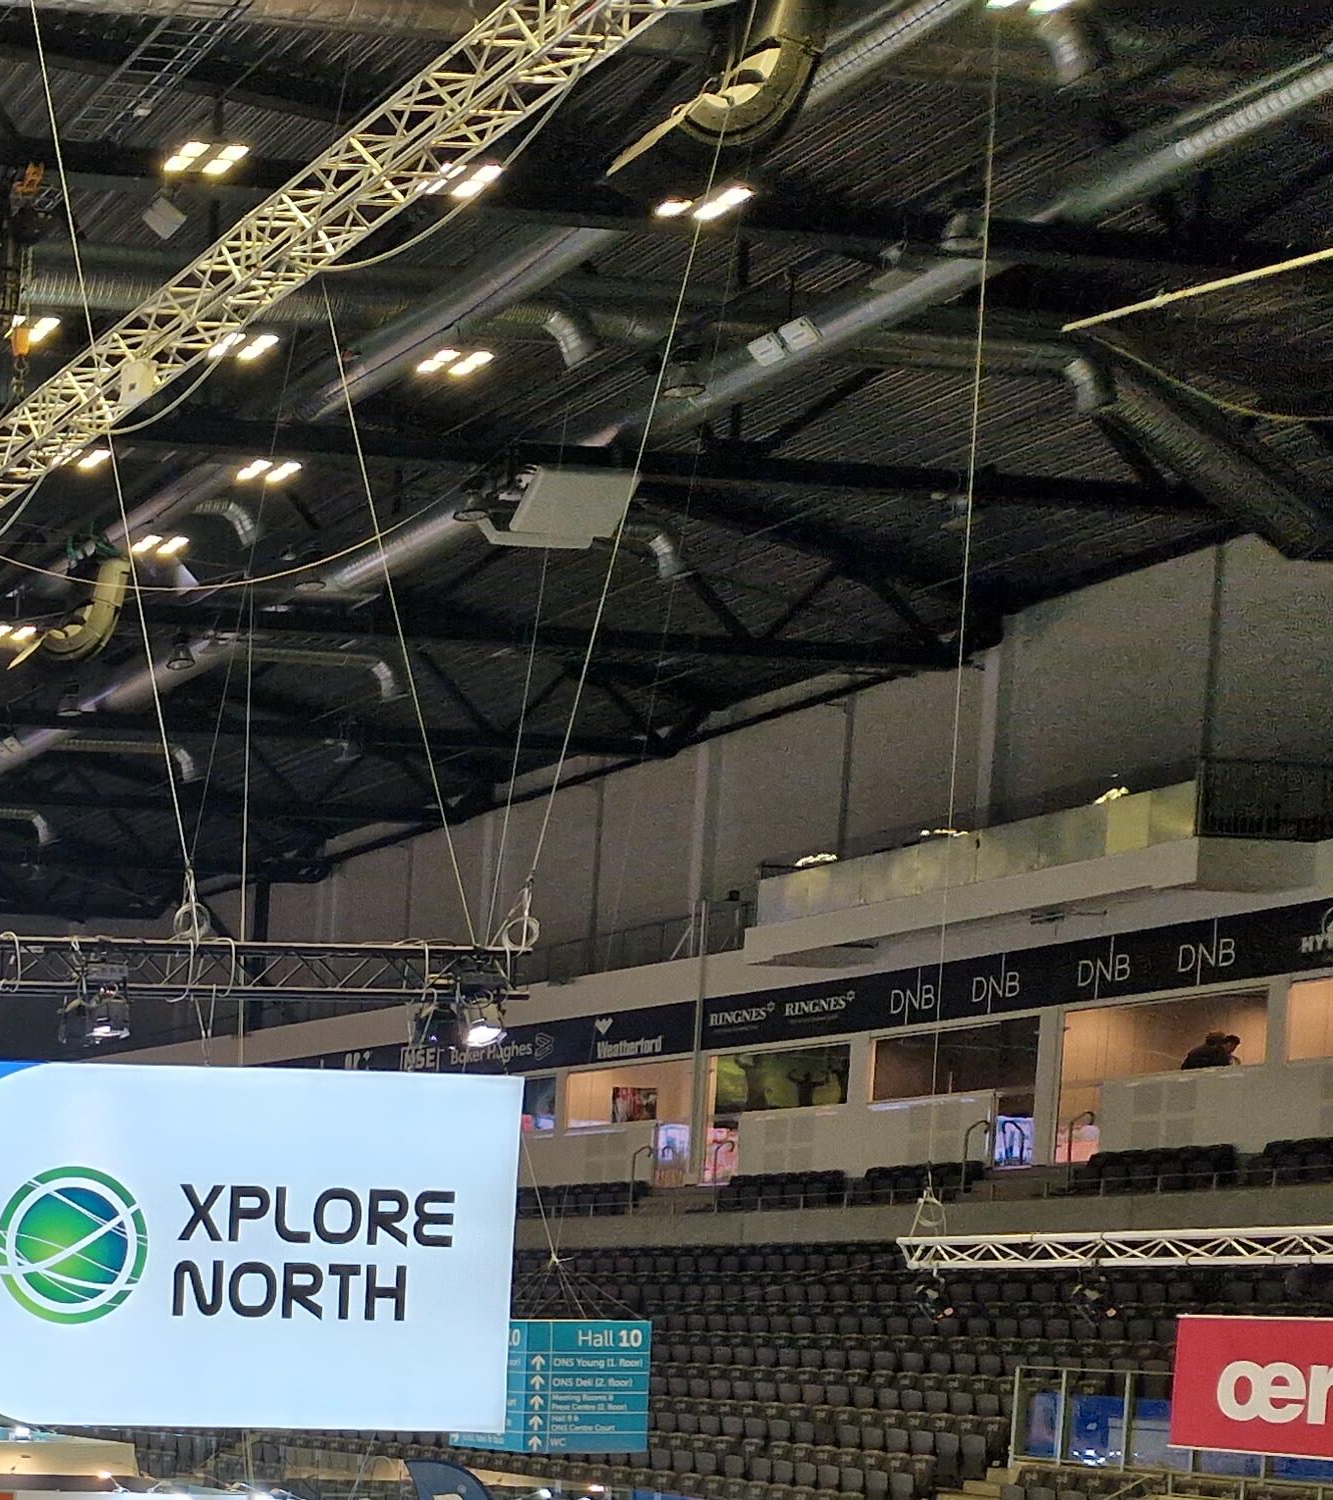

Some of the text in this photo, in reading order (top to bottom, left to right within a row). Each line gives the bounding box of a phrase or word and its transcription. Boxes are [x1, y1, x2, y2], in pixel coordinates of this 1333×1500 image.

[1178, 917, 1235, 985] DNB
[1077, 936, 1130, 1000] DNB
[971, 953, 1020, 1014] DNB
[785, 996, 846, 1016] RINGNES
[890, 968, 935, 1024] DNB
[709, 1007, 767, 1027] RINGNES
[450, 1043, 533, 1065] Baker Hughes
[597, 1036, 663, 1059] Weatherford
[177, 1183, 455, 1247] XPLORE
[172, 1260, 407, 1321] NORTH
[578, 1329, 643, 1347] Hall 10
[553, 1358, 574, 1366] ONS
[576, 1358, 605, 1368] Young
[619, 1358, 643, 1368] floor)
[552, 1378, 574, 1386] ONS
[576, 1378, 593, 1386] Deli
[608, 1378, 632, 1387] floor)
[550, 1438, 566, 1446] WC
